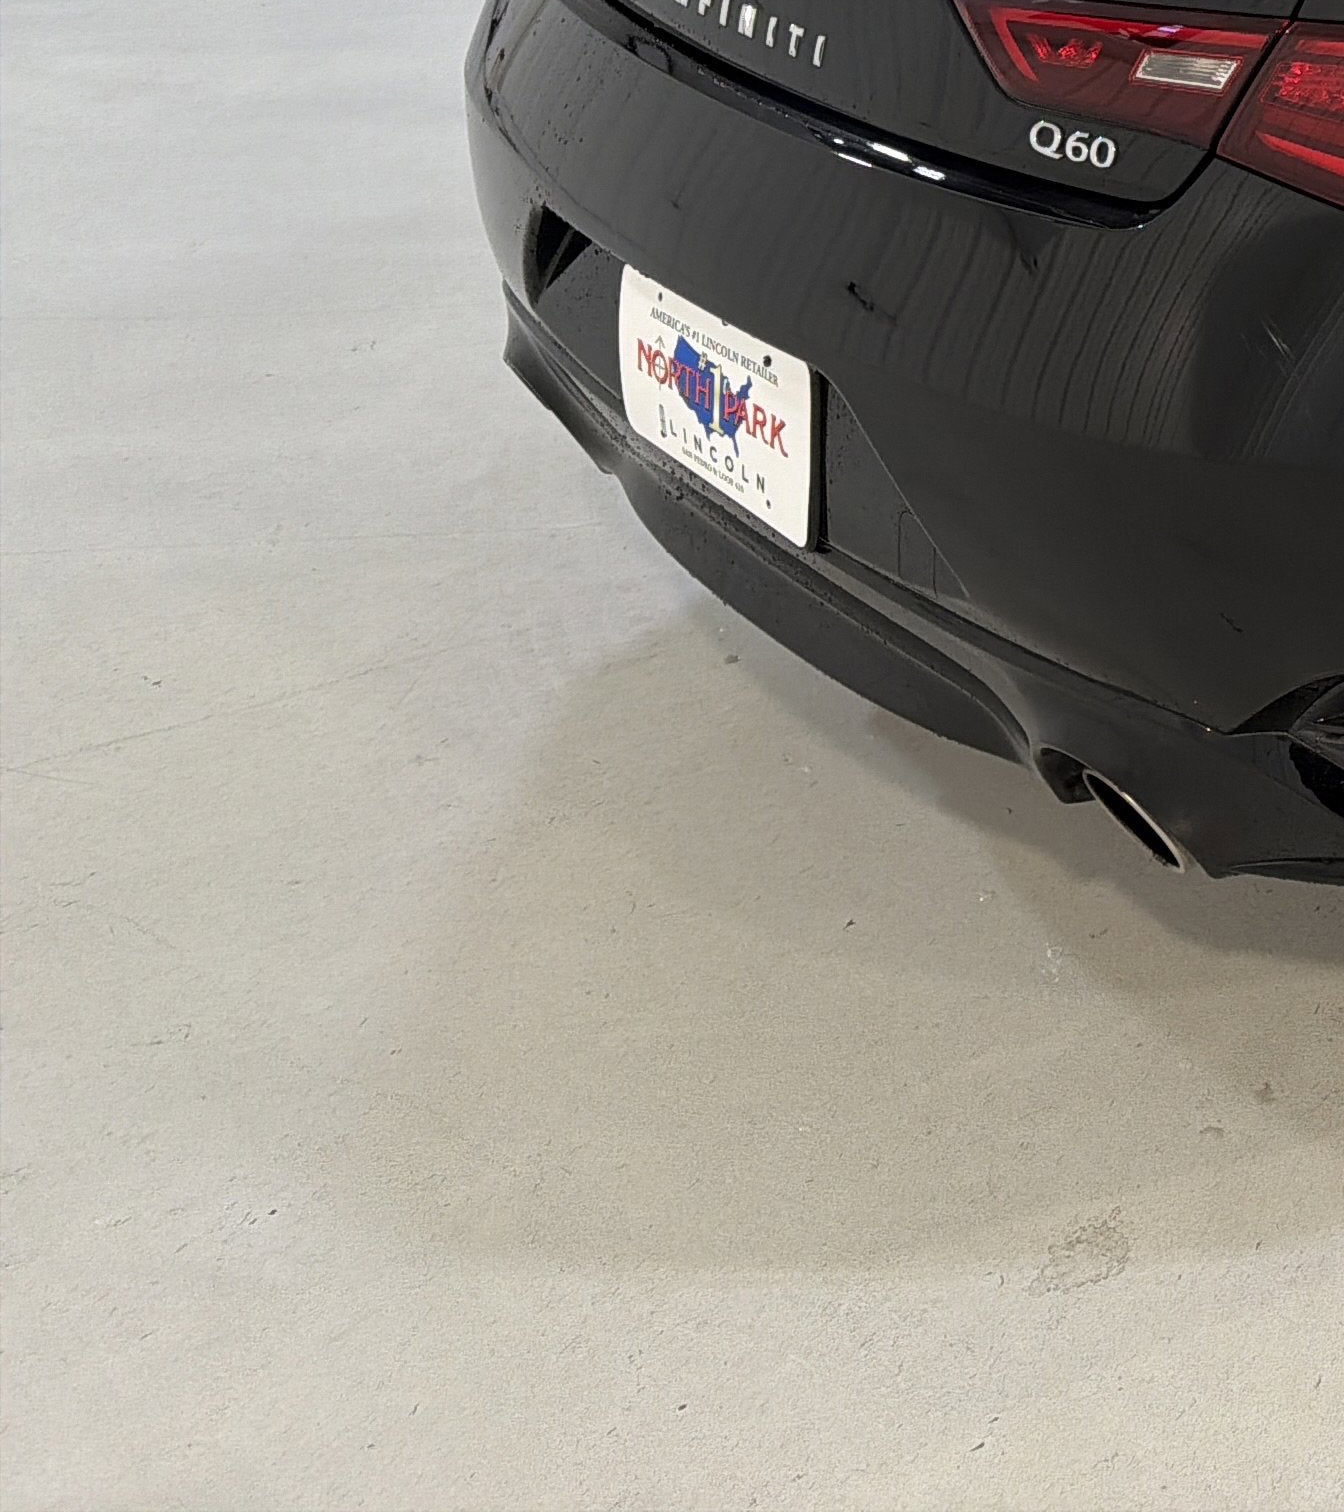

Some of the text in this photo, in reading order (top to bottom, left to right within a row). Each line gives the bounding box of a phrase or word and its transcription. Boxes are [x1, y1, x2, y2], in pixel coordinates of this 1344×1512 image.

[1028, 119, 1118, 169] Q60
[649, 306, 779, 388] AMERICA'S #1 LINCOLN RETAILER
[636, 337, 788, 458] NORTH PARK
[669, 418, 765, 494] LINCOLN
